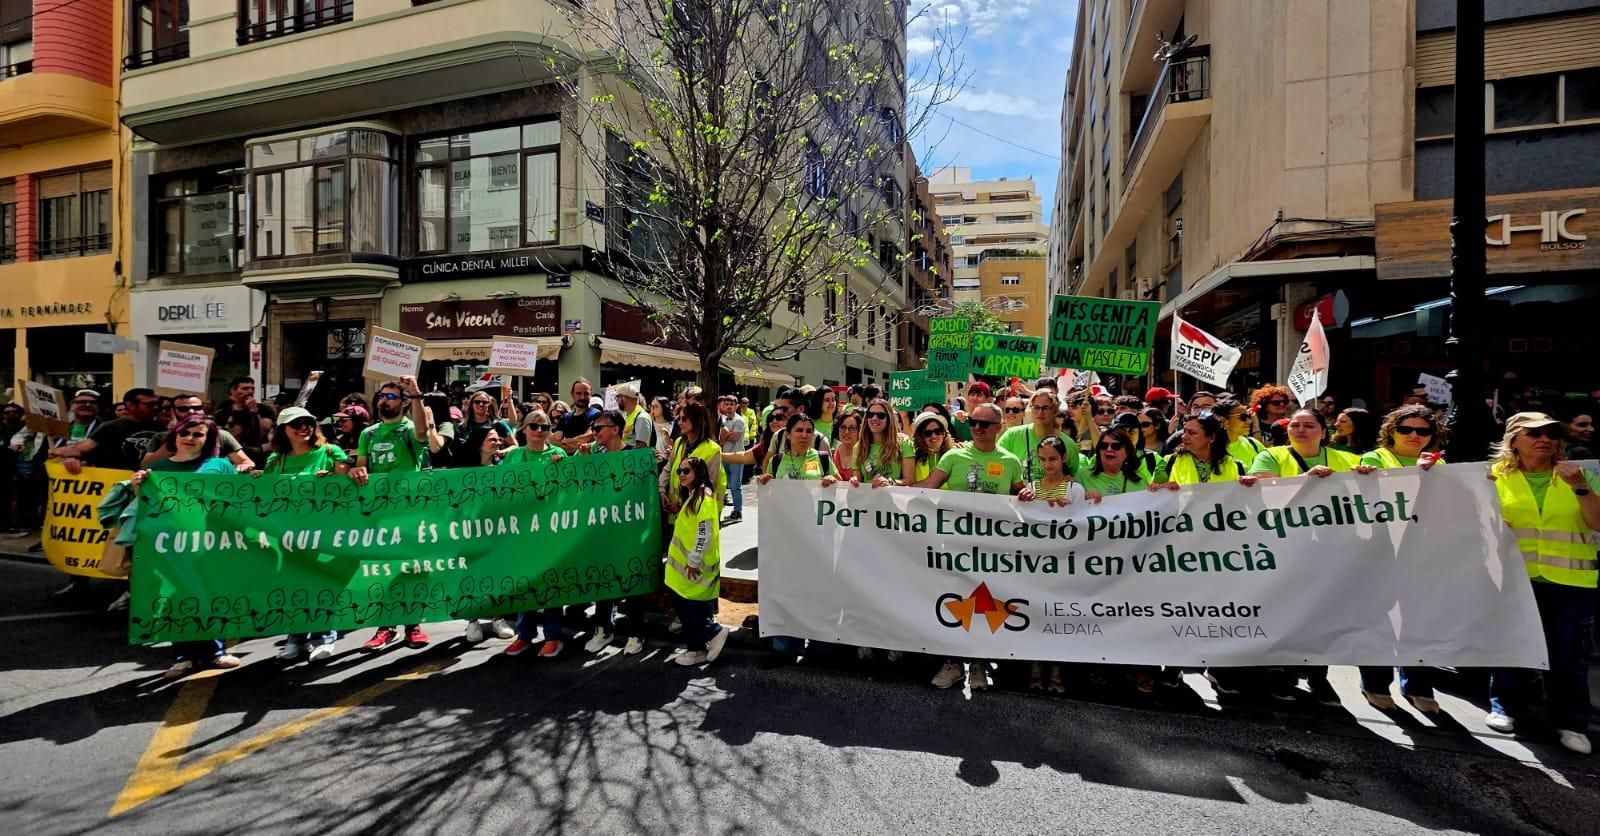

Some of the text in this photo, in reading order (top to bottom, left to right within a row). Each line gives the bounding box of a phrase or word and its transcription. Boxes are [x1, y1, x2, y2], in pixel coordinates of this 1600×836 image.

[1485, 208, 1587, 246] CHIC
[1540, 241, 1585, 251] BOLSOS
[423, 256, 530, 274] CLÍNICA DENTAL MILLET
[401, 304, 424, 313] Horno
[517, 299, 555, 308] Comidas
[1056, 299, 1149, 325] MÉS GENT A
[426, 308, 506, 329] San Vicente
[931, 319, 969, 332] DOCENTS
[974, 334, 994, 351] 30
[1053, 321, 1147, 348] CLASSE QUE A
[1049, 346, 1082, 365] UNA
[1176, 343, 1223, 366] STEPV
[53, 502, 91, 519] UNA
[816, 492, 1420, 542] Per una Educació Pública de qualitat,
[154, 500, 646, 553] CUIDAR A QUI EDUCA ÉS CUIDAR A QUI APRÉN
[362, 556, 469, 577] IES CÀRCER
[926, 542, 1277, 576] inclusiva i en valencià
[1044, 601, 1263, 619] I.E.S. Carles Salvador
[1042, 623, 1268, 640] ALDAIA VALÈNCIA
